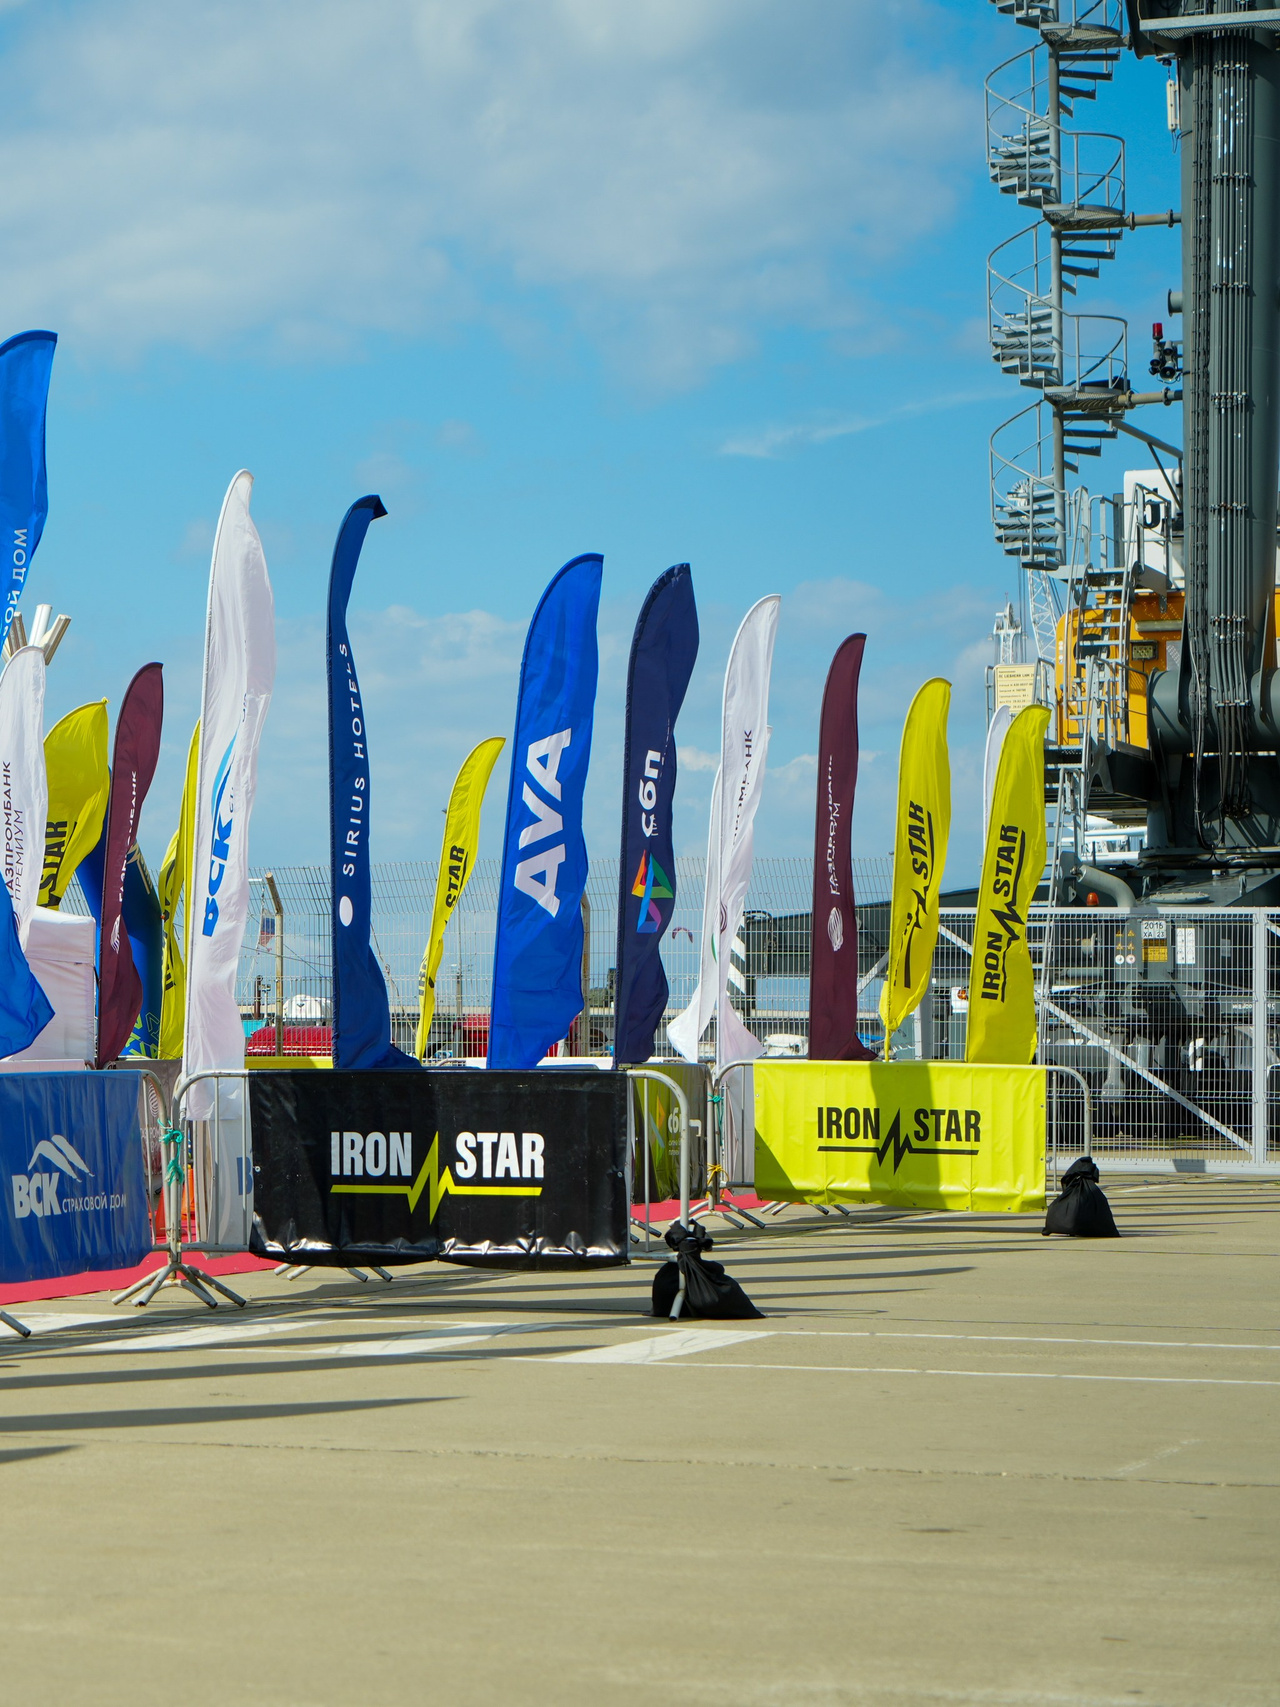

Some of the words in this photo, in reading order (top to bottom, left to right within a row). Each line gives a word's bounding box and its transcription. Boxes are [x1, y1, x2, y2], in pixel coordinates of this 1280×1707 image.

[12, 528, 29, 581] ДОМ
[339, 642, 364, 759] HOTELS
[13, 808, 25, 901] ПРЕМИУМ
[342, 776, 366, 877] SIRIUS
[514, 728, 572, 919] AVA
[908, 800, 929, 881] STAR
[444, 843, 466, 911] STAR
[981, 931, 1003, 1001] IRON
[992, 823, 1019, 898] STAR
[330, 1131, 413, 1178] IRON
[455, 1130, 546, 1179] STAR
[667, 1106, 682, 1134] сб
[817, 1106, 880, 1140] IRON
[913, 1107, 981, 1142] STAR
[11, 1171, 62, 1219] ВСК
[62, 1191, 108, 1213] СТРАХОВОЙ
[109, 1193, 127, 1211] ДОМ
